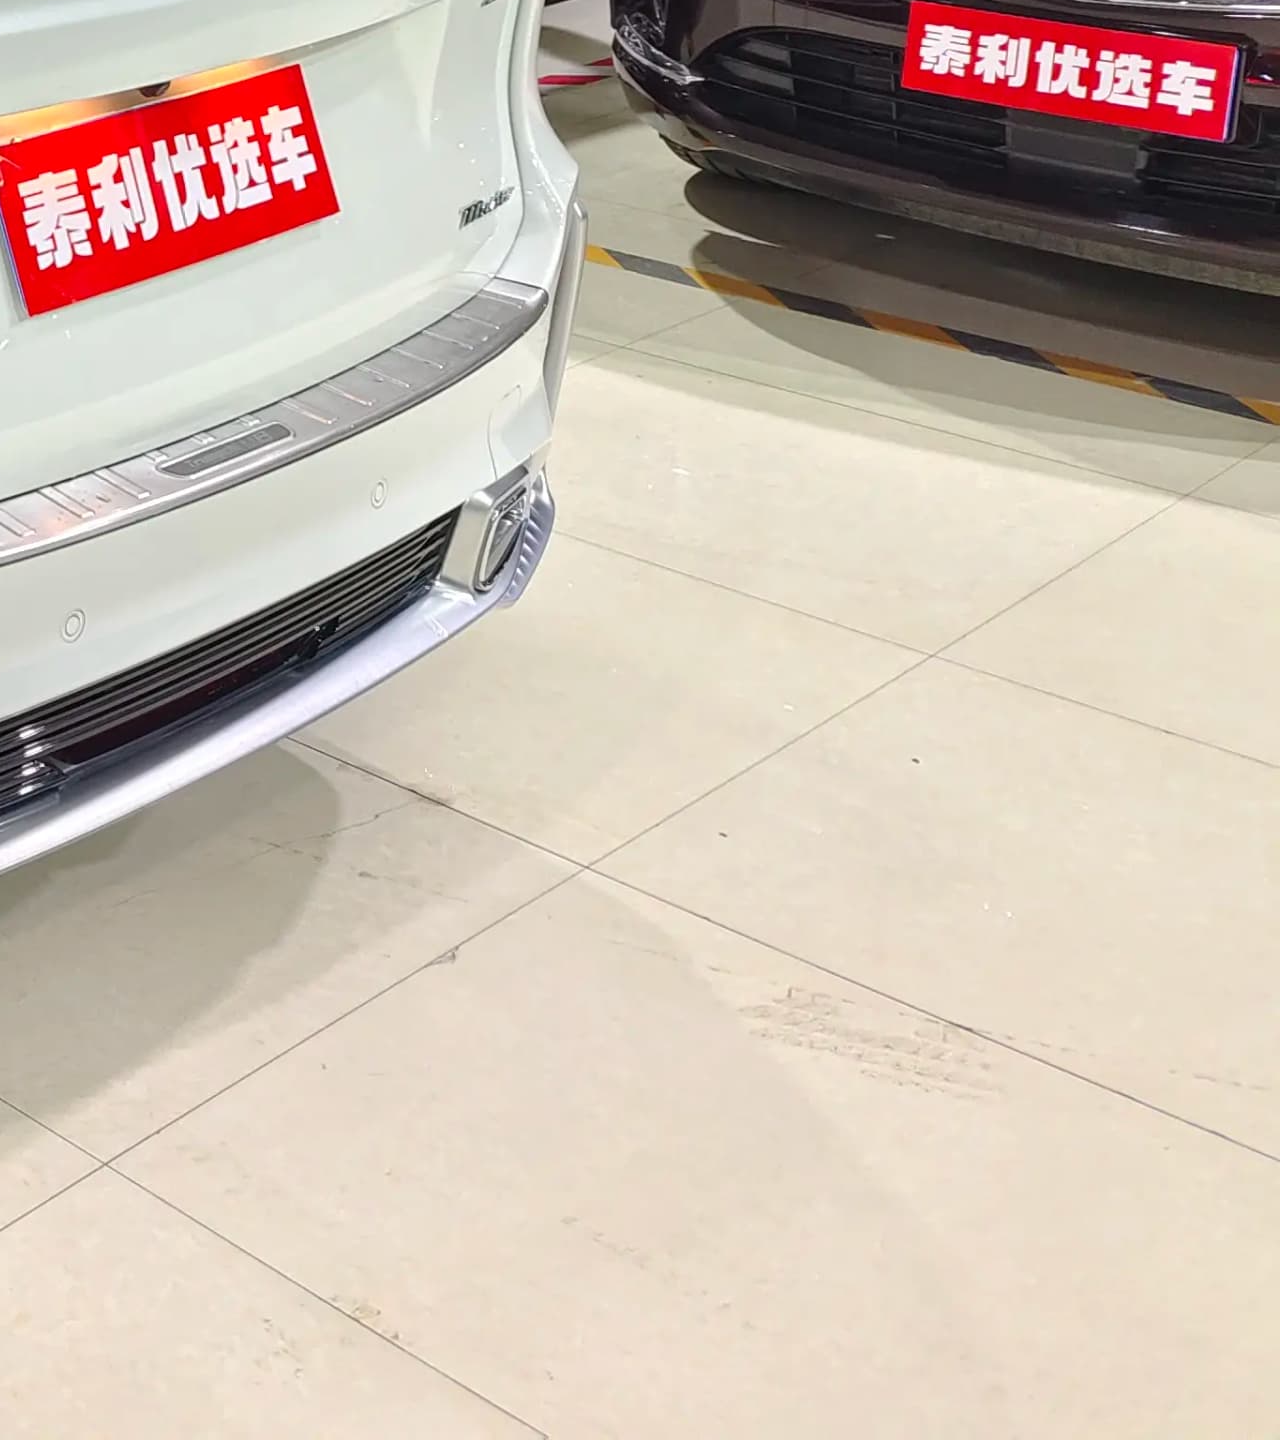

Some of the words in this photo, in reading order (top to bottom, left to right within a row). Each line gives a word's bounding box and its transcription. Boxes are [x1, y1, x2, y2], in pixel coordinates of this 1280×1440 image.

[918, 23, 1218, 117] 泰利优选车
[16, 105, 318, 272] 泰利优选车
